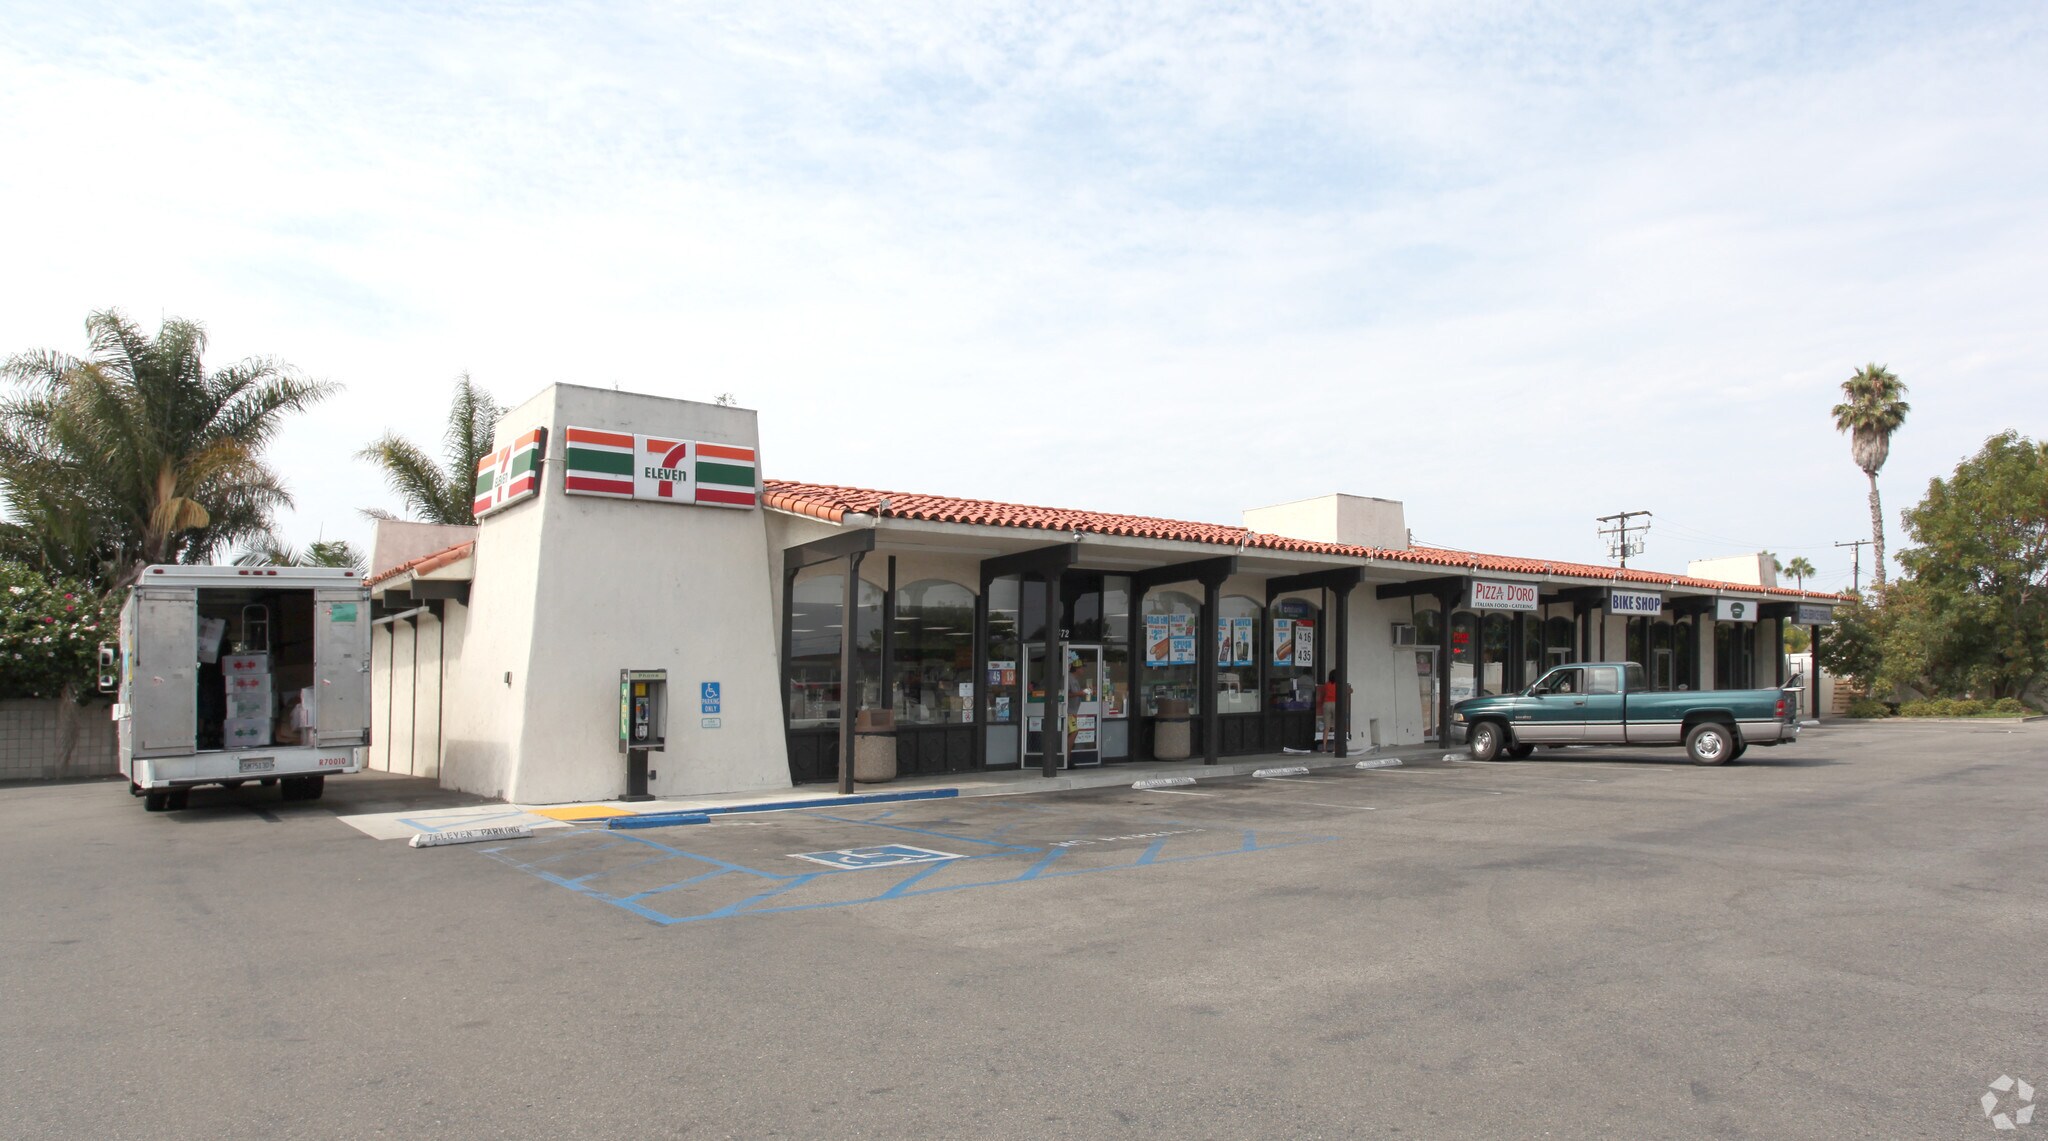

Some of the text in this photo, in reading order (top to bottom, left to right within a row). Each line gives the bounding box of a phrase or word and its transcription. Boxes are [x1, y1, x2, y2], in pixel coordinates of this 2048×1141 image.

[647, 438, 686, 497] 7
[1475, 583, 1534, 601] PIZZA D'ORO
[1613, 595, 1660, 611] BIKE SHOP
[319, 758, 346, 766] R70010
[481, 826, 520, 836] PARKING
